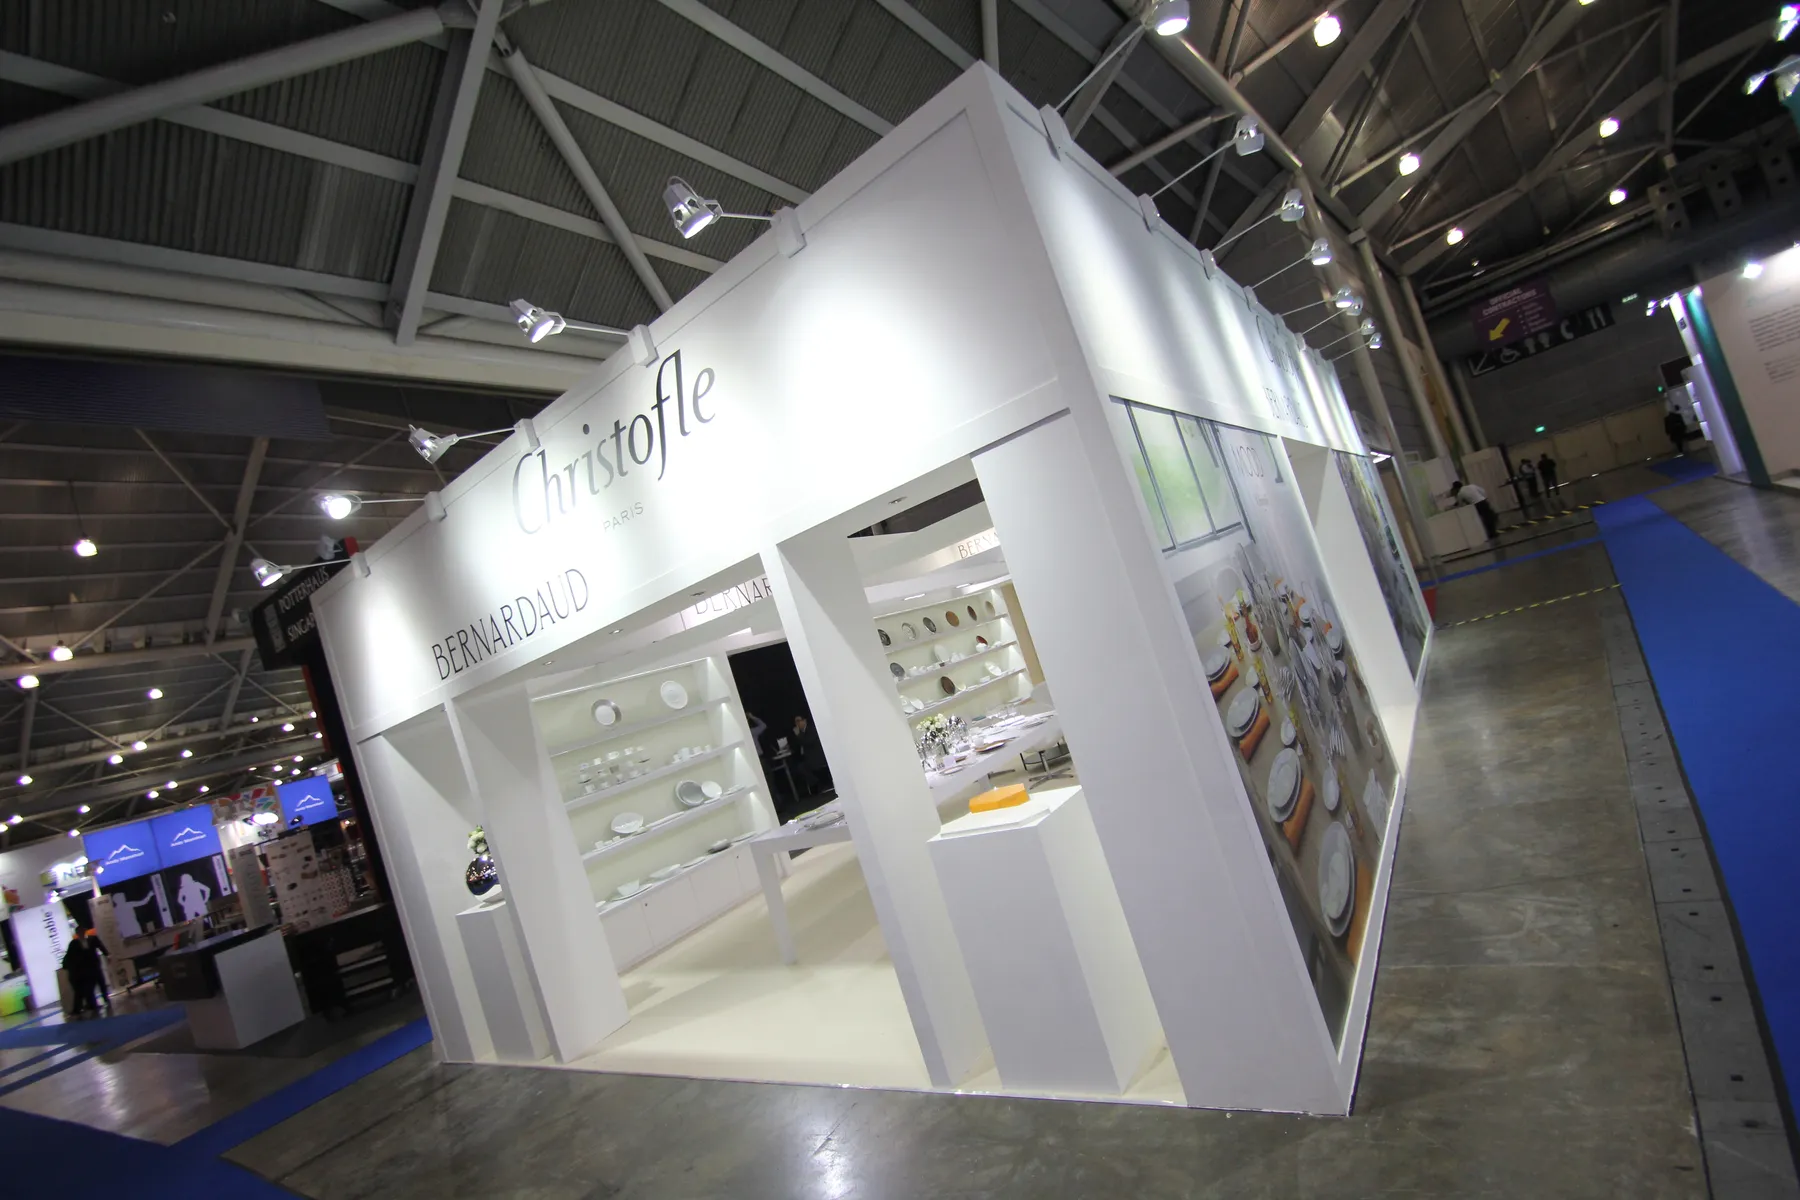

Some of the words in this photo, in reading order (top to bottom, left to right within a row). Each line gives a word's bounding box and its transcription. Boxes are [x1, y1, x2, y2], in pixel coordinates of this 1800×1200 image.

[512, 348, 717, 535] Christofle
[602, 501, 644, 533] PARIS
[431, 568, 589, 681] BERNARDAUD
